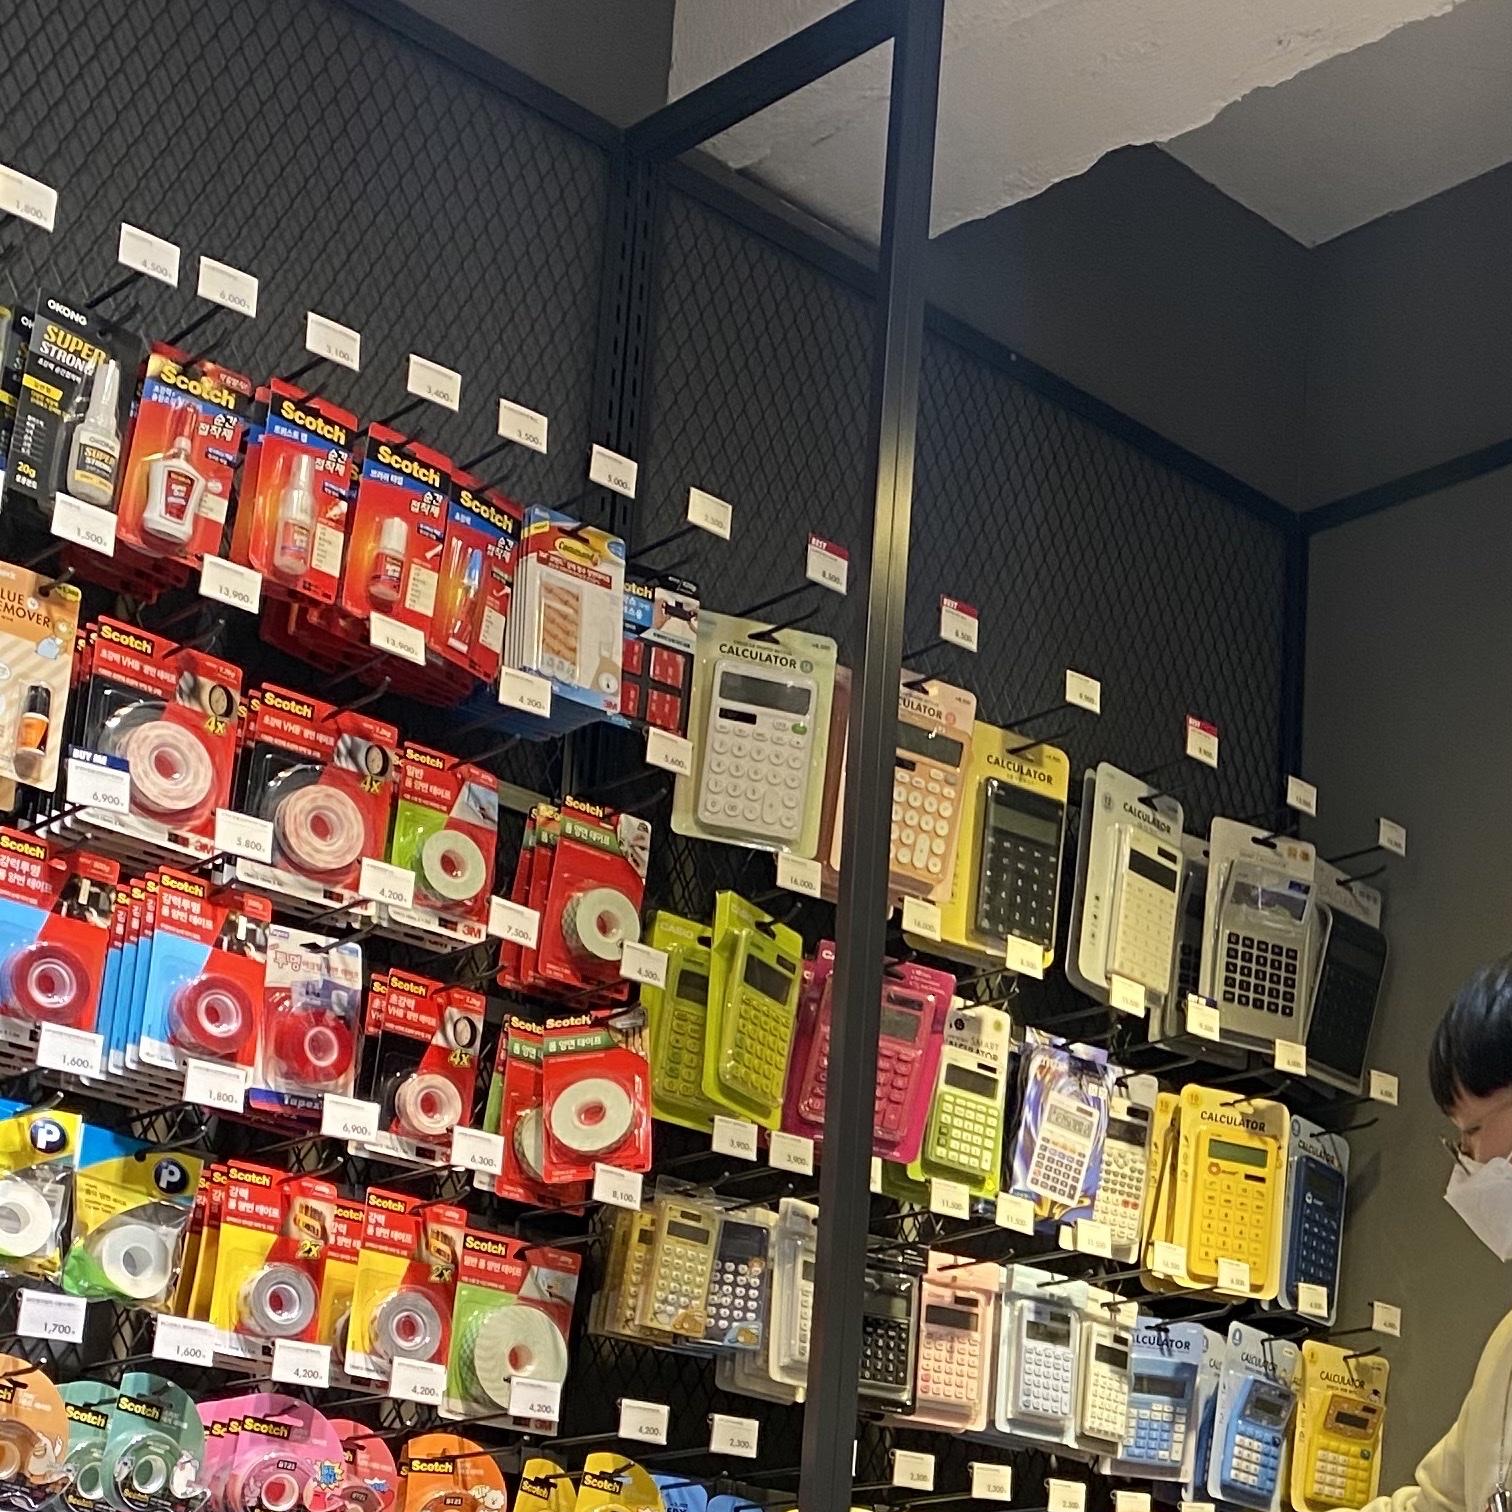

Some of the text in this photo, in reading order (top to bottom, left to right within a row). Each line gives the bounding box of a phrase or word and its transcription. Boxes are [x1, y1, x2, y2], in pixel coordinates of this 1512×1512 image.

[47, 299, 88, 326] OKONG
[43, 324, 107, 365] SUPER
[39, 341, 95, 376] STRONG
[160, 362, 236, 409] Scotch
[281, 400, 347, 446] Scotch
[377, 445, 441, 489] Scotch
[459, 490, 514, 534] Scotch
[100, 625, 152, 654] Scotch
[719, 644, 797, 670] CALCULATOR
[264, 692, 312, 718] Scotch
[986, 754, 1053, 785] CALCULATOR
[92, 791, 120, 806] 6,900
[1123, 803, 1171, 834] CALCULATOR
[161, 874, 203, 897] Scotch
[379, 887, 404, 903] 4,200
[62, 1054, 90, 1069] 1,600
[209, 1089, 235, 1104] 1,800
[342, 1122, 368, 1136] 6,900
[1200, 1110, 1266, 1133] CALCULATOR
[470, 1154, 494, 1168] 6,300
[229, 1168, 270, 1186] Scotch
[43, 1322, 71, 1335] 1,700
[176, 1345, 202, 1359] 1,600
[293, 1368, 319, 1380] 4,200
[1320, 1370, 1365, 1390] CALCULATOR
[411, 1384, 436, 1397] 4,200
[65, 1405, 107, 1427] Scotch
[119, 1397, 160, 1419] Scotch
[244, 1417, 288, 1437] Scotch
[411, 1458, 452, 1474] Scotch
[584, 1474, 620, 1493] Scotch
